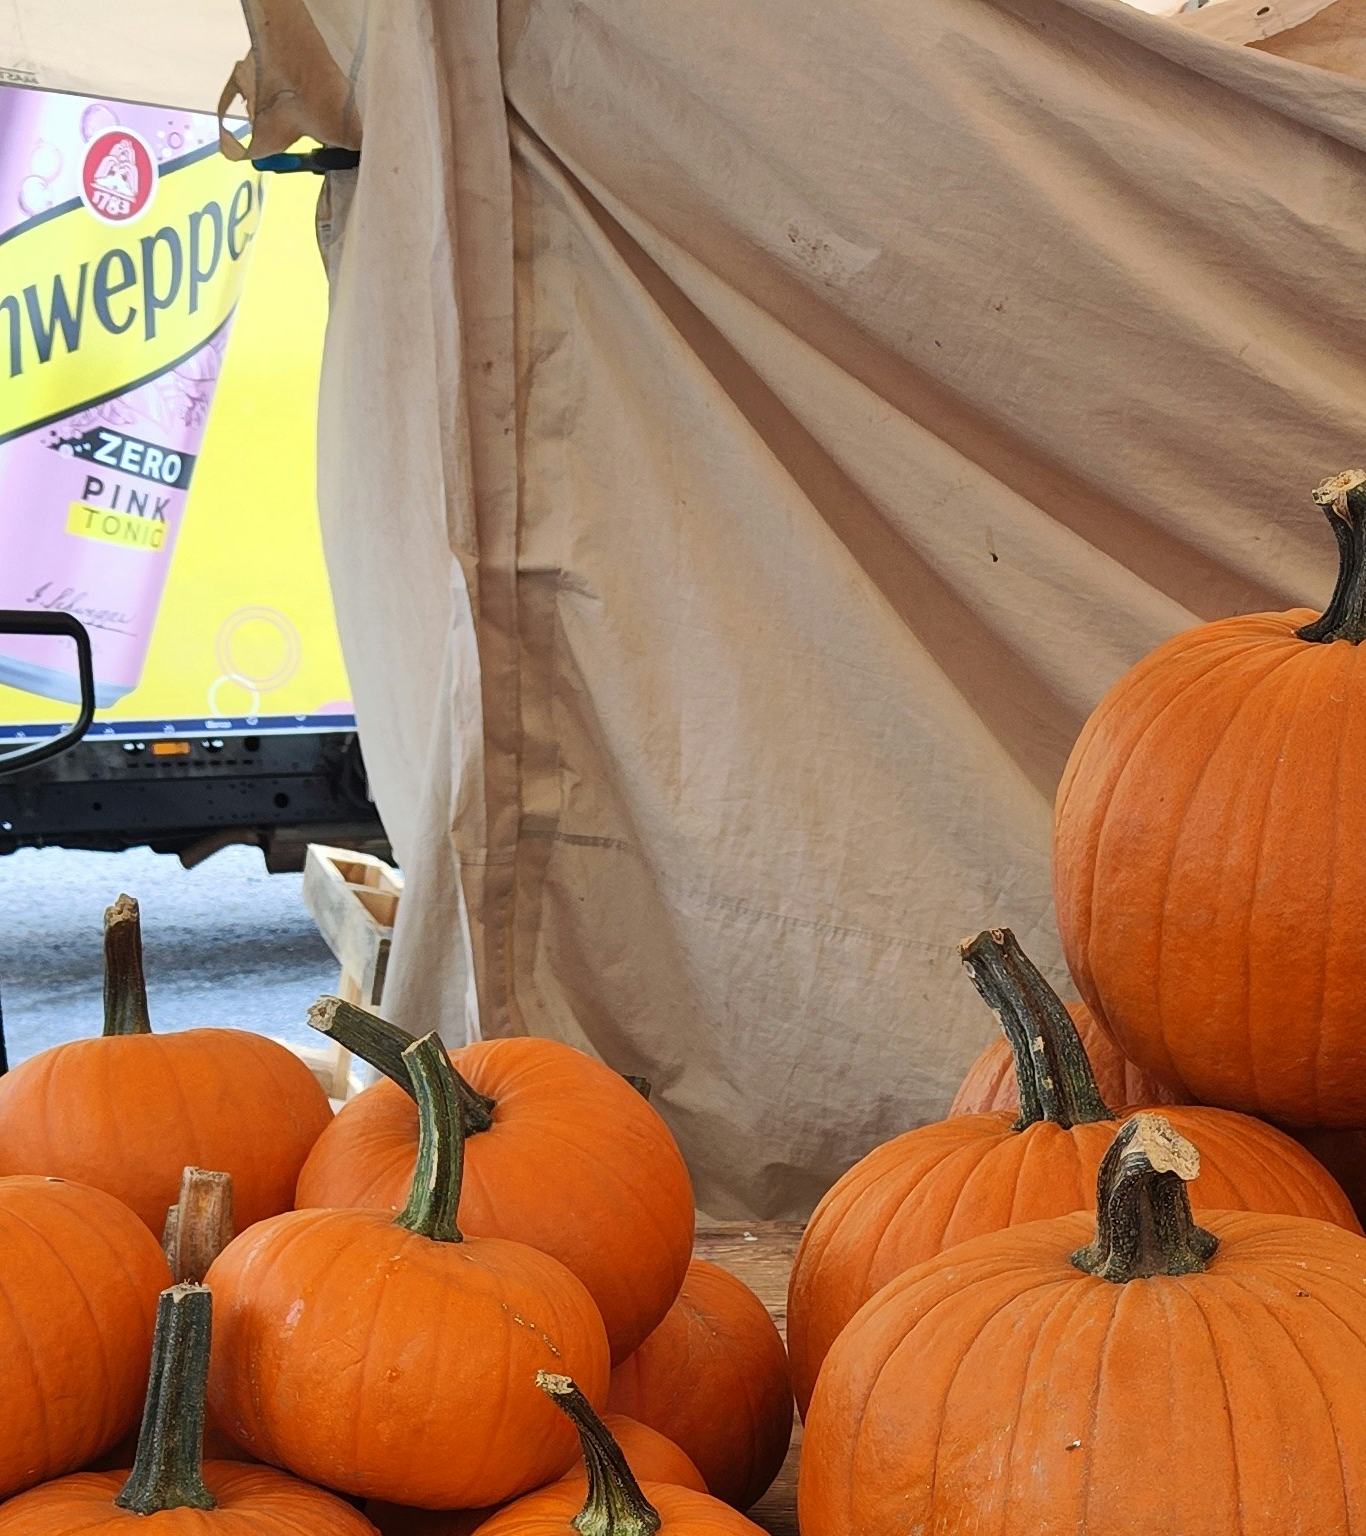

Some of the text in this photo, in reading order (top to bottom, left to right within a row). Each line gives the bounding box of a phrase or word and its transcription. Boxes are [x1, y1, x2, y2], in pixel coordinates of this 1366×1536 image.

[93, 430, 182, 484] ZERO
[81, 475, 172, 525] PINK
[81, 506, 164, 549] TONIC
